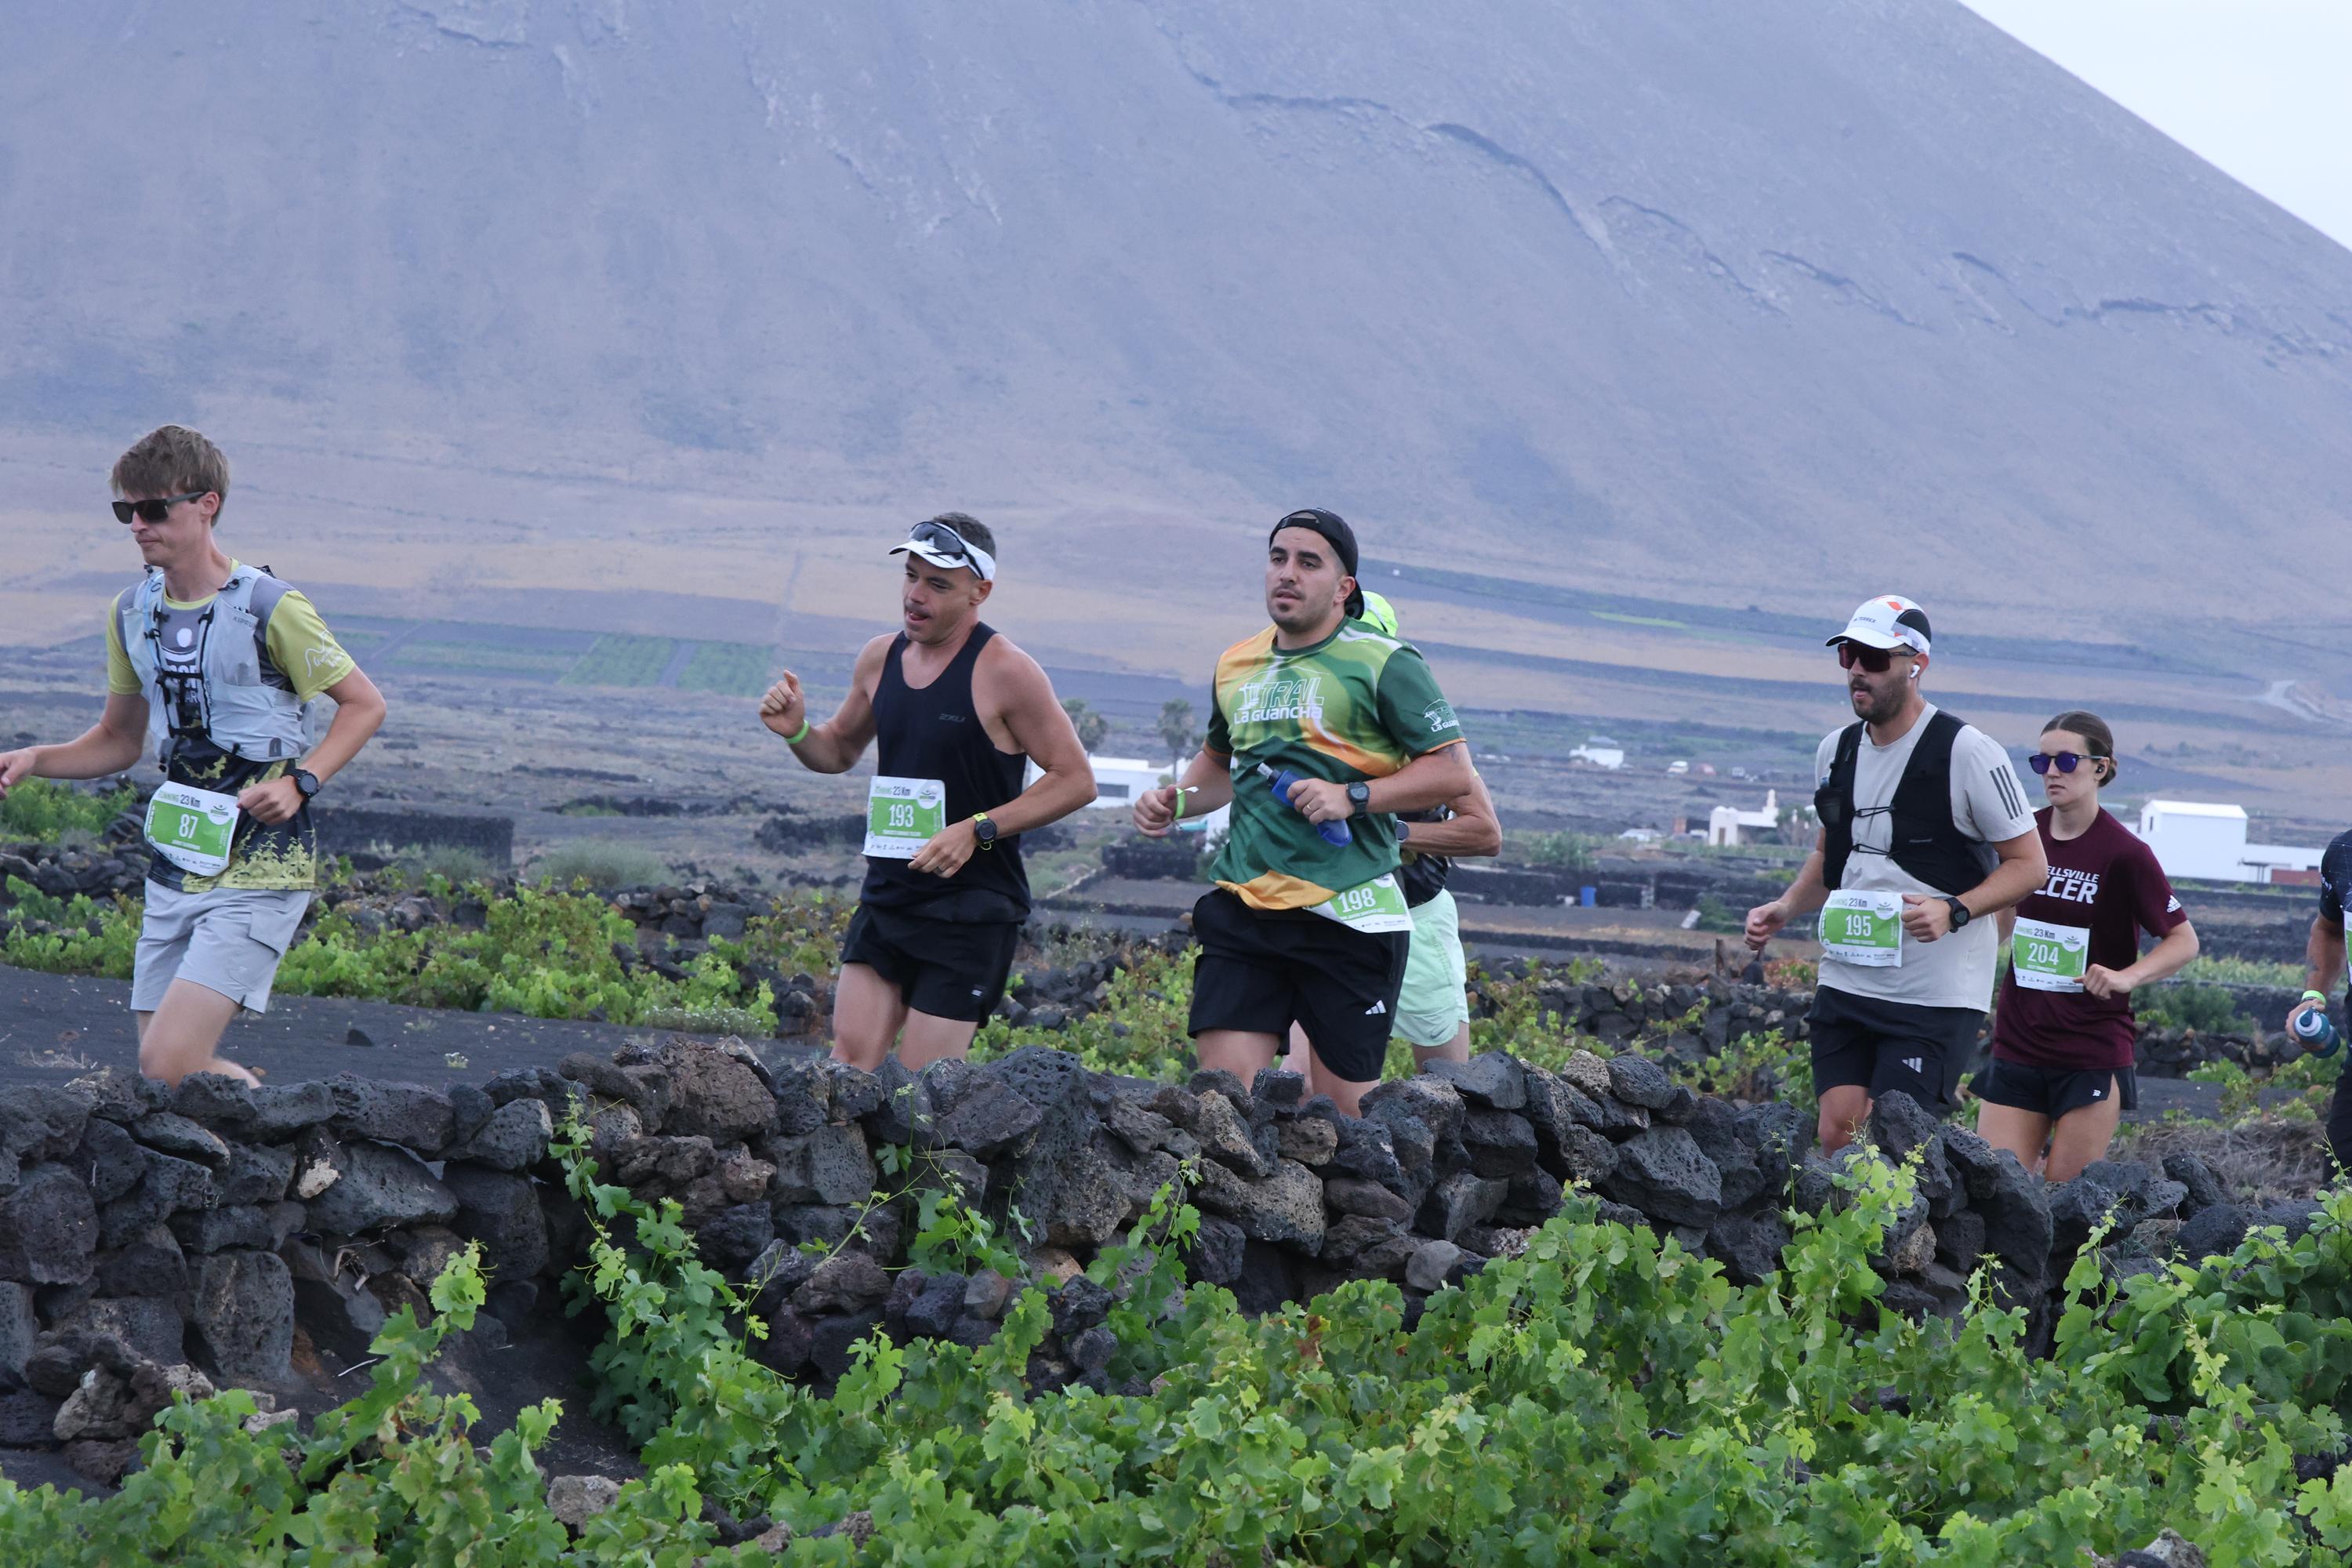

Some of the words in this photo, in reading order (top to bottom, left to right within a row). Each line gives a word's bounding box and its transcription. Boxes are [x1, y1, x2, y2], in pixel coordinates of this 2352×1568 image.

[1260, 677, 1325, 709] TRAIL
[179, 813, 198, 839] 87
[889, 804, 914, 828] 193
[1338, 887, 1376, 913] 198
[1846, 914, 1871, 937] 195
[2034, 928, 2044, 937] 23
[2045, 930, 2055, 939] Km
[2027, 942, 2059, 966] 204
